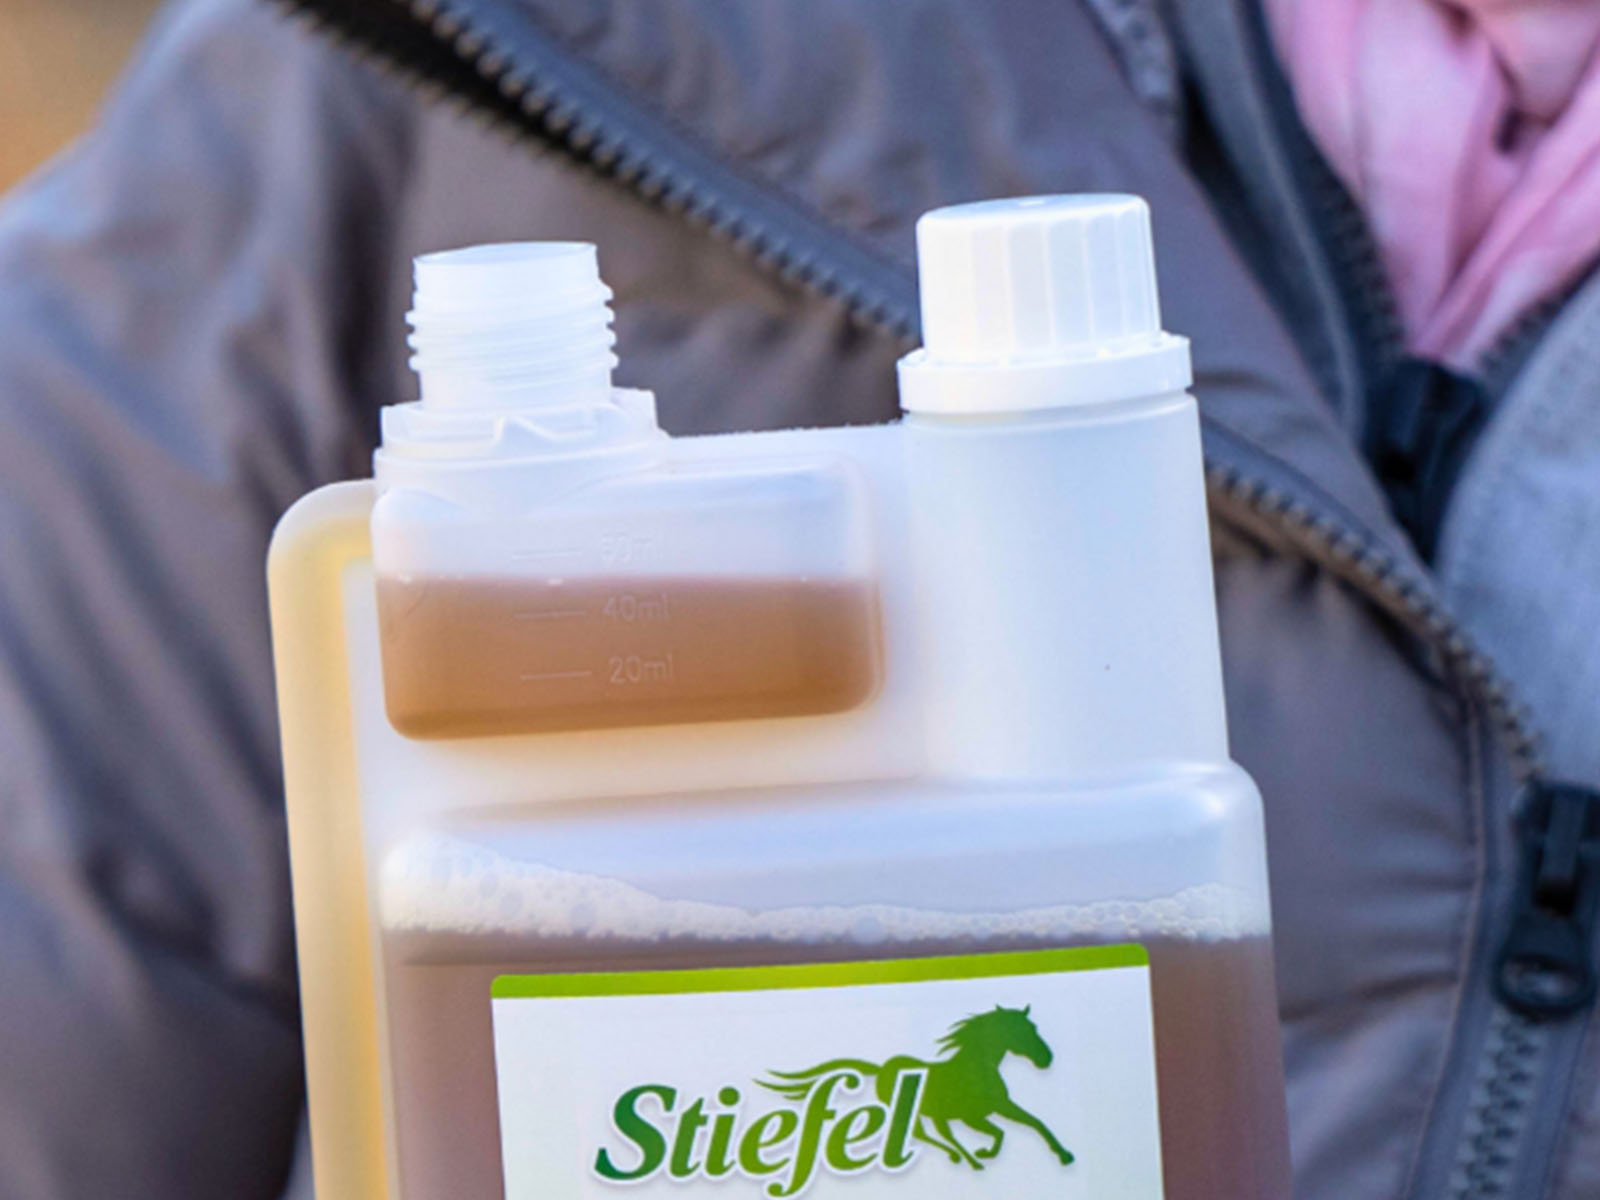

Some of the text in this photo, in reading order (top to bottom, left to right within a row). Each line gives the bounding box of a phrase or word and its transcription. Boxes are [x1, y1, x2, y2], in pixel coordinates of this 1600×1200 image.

[602, 592, 672, 623] 40ml
[608, 652, 675, 685] 20ml
[594, 1068, 926, 1198] Stiefel
